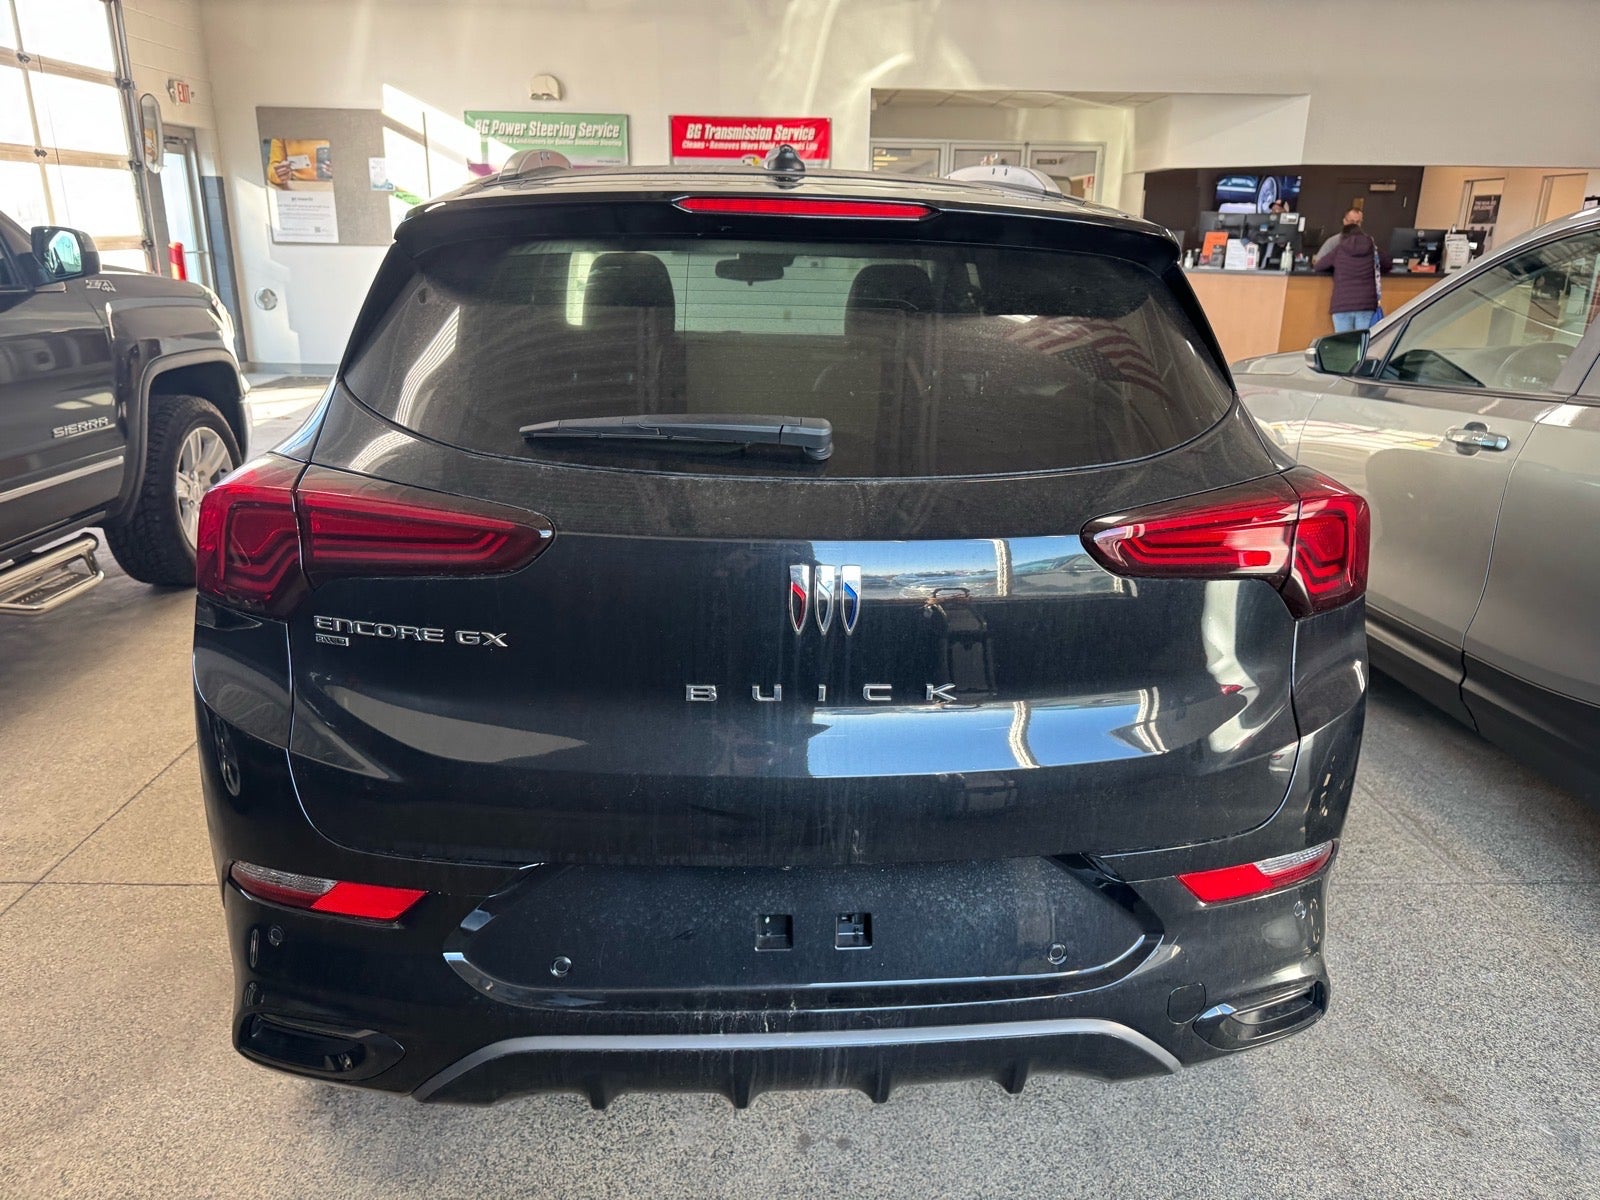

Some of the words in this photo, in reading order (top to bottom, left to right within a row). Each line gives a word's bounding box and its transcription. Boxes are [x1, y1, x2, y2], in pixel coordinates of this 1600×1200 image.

[177, 83, 190, 104] EXIT
[475, 118, 491, 136] BG
[492, 120, 527, 137] Power
[529, 121, 576, 140] Steering
[579, 122, 620, 138] Service
[686, 123, 703, 139] BG
[704, 124, 773, 141] Transmission
[774, 124, 816, 141] Service
[709, 140, 740, 150] Removes
[52, 416, 109, 438] SIERRA
[313, 615, 445, 643] ENCORE
[455, 630, 508, 647] GX
[315, 633, 349, 647] AWD
[685, 683, 957, 702] BUICK
